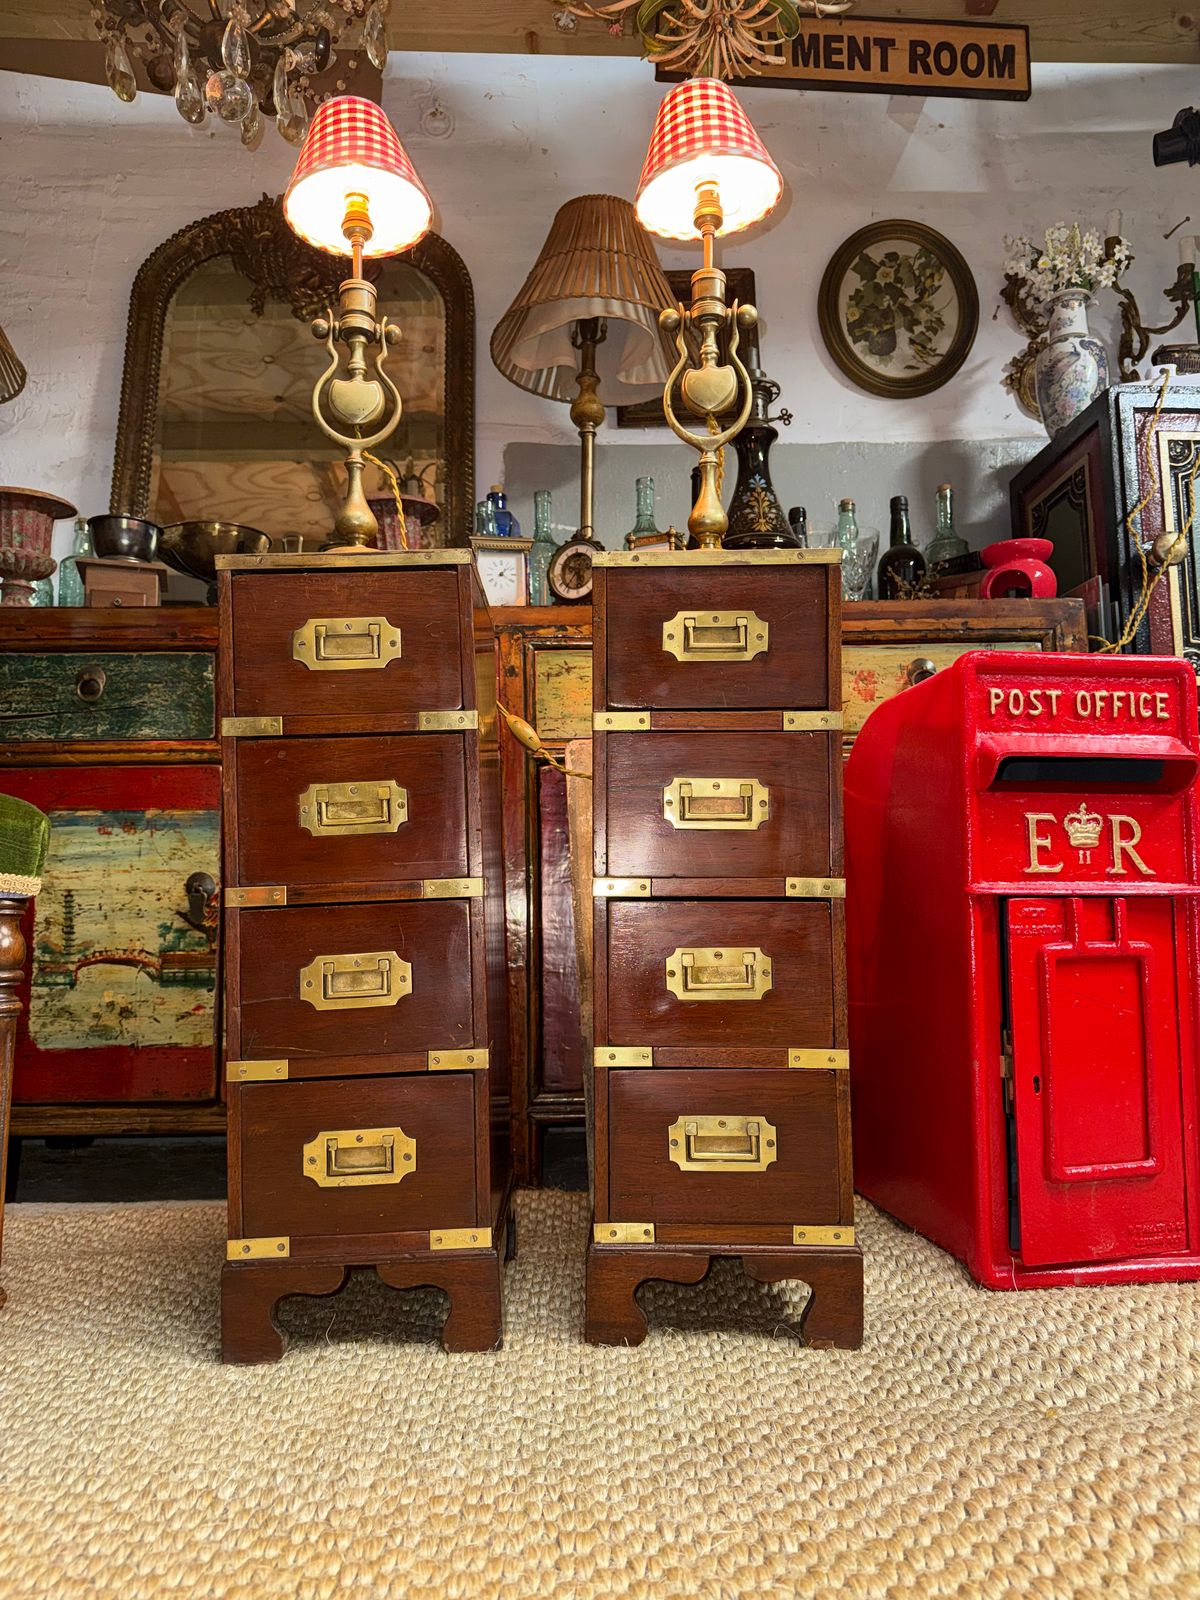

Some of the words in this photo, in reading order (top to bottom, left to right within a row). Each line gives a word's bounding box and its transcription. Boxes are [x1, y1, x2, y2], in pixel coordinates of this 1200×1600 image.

[908, 39, 1016, 80] ROOM
[989, 687, 1063, 716] POST
[1075, 689, 1170, 719] OFFICE
[1023, 812, 1064, 874] E
[1106, 814, 1157, 875] R
